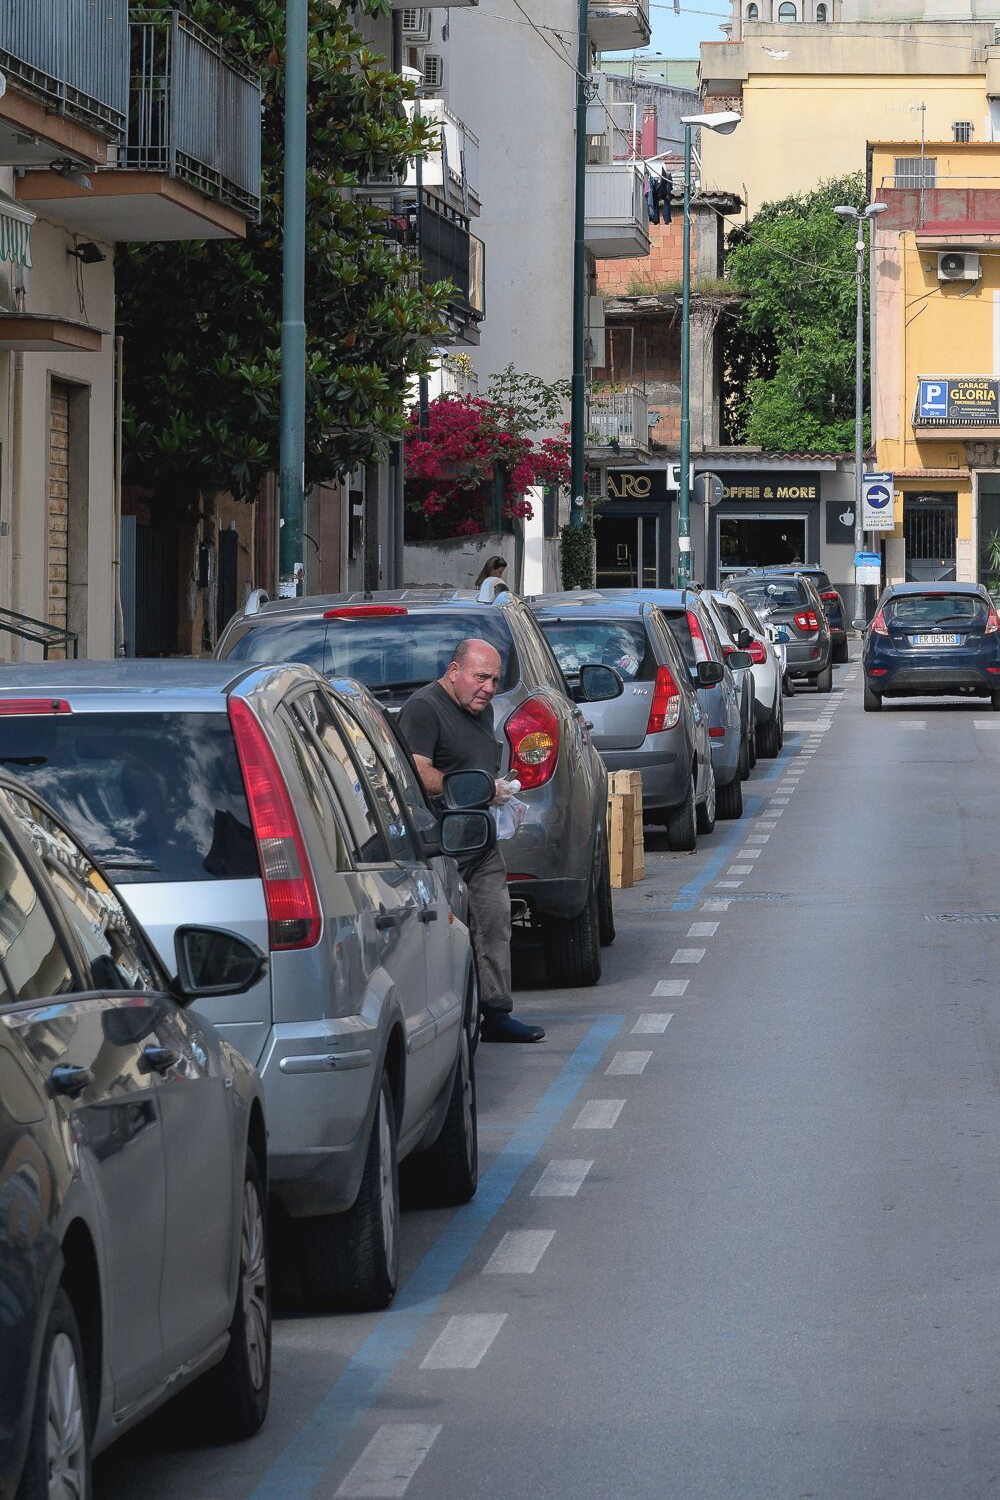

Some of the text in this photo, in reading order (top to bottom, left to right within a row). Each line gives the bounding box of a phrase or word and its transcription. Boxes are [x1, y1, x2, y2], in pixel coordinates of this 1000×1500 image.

[927, 385, 942, 403] P
[950, 389, 996, 401] GLORIA
[722, 486, 816, 498] OFFEE & MORE
[919, 635, 929, 643] ER
